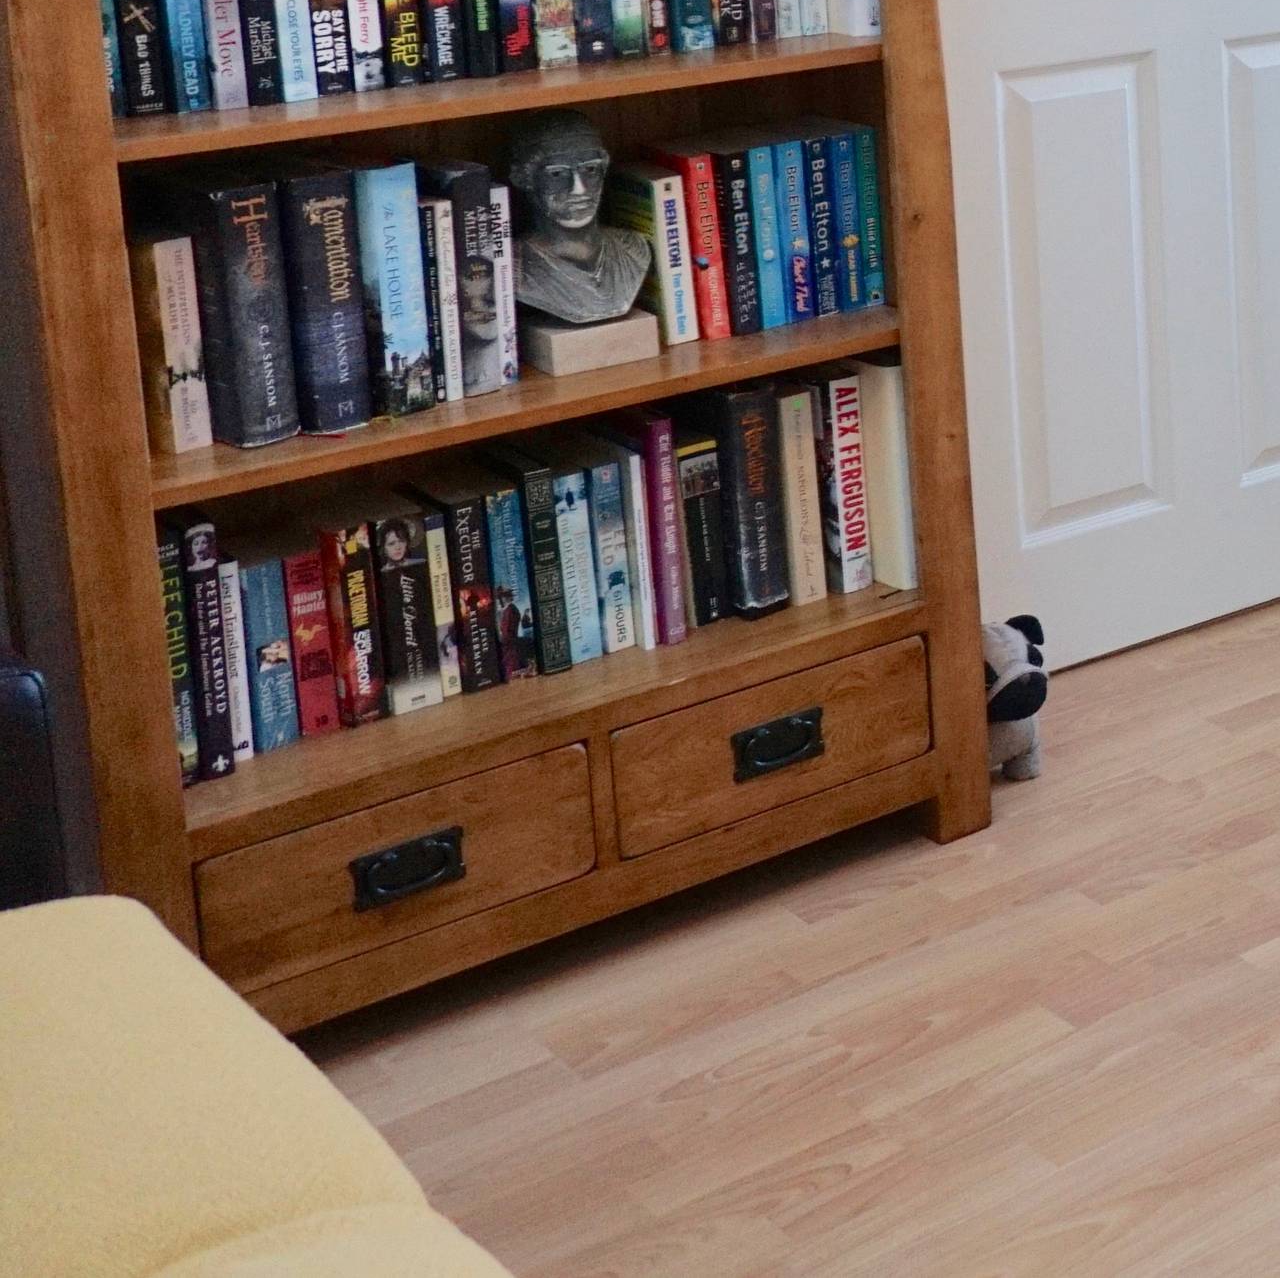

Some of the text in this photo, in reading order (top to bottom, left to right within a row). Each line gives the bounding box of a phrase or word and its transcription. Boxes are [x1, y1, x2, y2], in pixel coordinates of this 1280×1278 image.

[246, 16, 264, 64] Marshall
[260, 19, 277, 60] Michael
[331, 9, 349, 72] SAY YOU'RE
[358, 16, 371, 44] Ferry
[399, 12, 419, 67] BLEED
[434, 5, 454, 66] WRECKAGE
[651, 0, 665, 28] ONE
[135, 34, 155, 97] BAD THINGS
[178, 9, 200, 95] LONELY DEAD
[219, 28, 237, 77] Move
[289, 30, 301, 56] YOUR
[292, 58, 303, 81] EYES
[312, 10, 337, 74] SORRY
[390, 37, 404, 63] ME
[696, 181, 717, 256] Ben Elton
[730, 178, 751, 256] Ben Elton
[786, 165, 802, 233] Ben Elton
[811, 158, 831, 251] Ben Elton
[839, 161, 855, 233] Ben Elton
[304, 196, 355, 303] Lamentation
[463, 209, 477, 258] MILLER
[476, 204, 488, 255] ANDREW
[490, 202, 505, 259] SHARPE
[663, 198, 683, 268] BEN ELTON
[382, 224, 403, 321] LAKE HOUSE
[793, 255, 806, 283] Chart
[166, 286, 178, 331] MURDER
[258, 324, 270, 338] C.
[262, 353, 278, 408] SANSOM
[834, 386, 868, 552] ALEX FERGUSON
[456, 505, 475, 583] EXECUTOR
[471, 528, 482, 550] THE
[756, 524, 768, 571] SANSOM
[161, 564, 182, 604] LEE
[346, 569, 370, 628] PRAETORIAN
[400, 574, 415, 603] Little
[563, 538, 583, 642] DEATH INSTINCT
[165, 610, 188, 680] CHILD
[205, 578, 228, 714] PETER ACKROYD
[221, 574, 240, 679] Lost in Translation
[468, 608, 483, 675] KELLERMAN
[479, 627, 489, 652] JESSE
[615, 604, 627, 643] HOURS
[353, 630, 372, 695] SCARROW
[181, 690, 191, 705] NO
[260, 677, 274, 724] South
[277, 671, 295, 717] North
